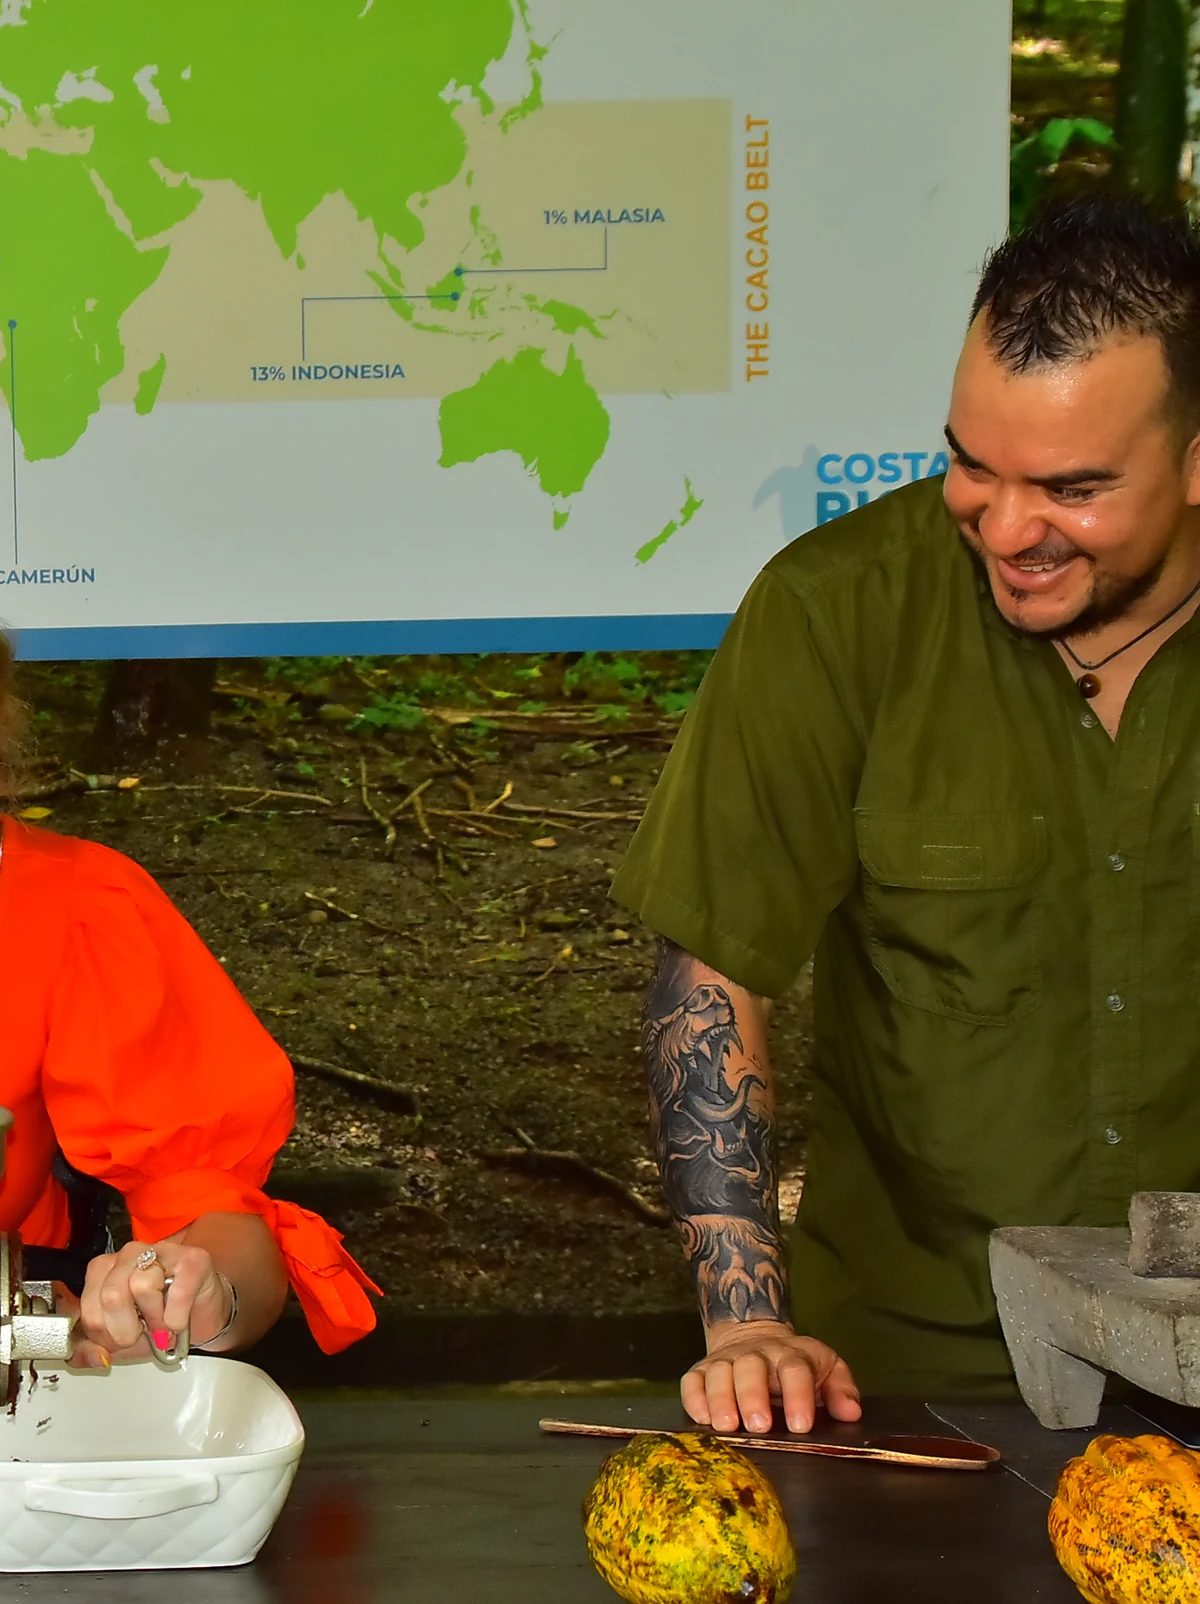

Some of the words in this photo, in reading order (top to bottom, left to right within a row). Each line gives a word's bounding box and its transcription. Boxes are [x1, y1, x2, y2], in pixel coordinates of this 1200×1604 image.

[746, 115, 769, 191] BELT
[544, 209, 568, 225] 1%
[574, 208, 666, 225] MALASIA
[746, 202, 769, 312] CACAO
[250, 366, 286, 382] 13%
[292, 364, 405, 381] INDONESIA
[746, 323, 769, 381] THE
